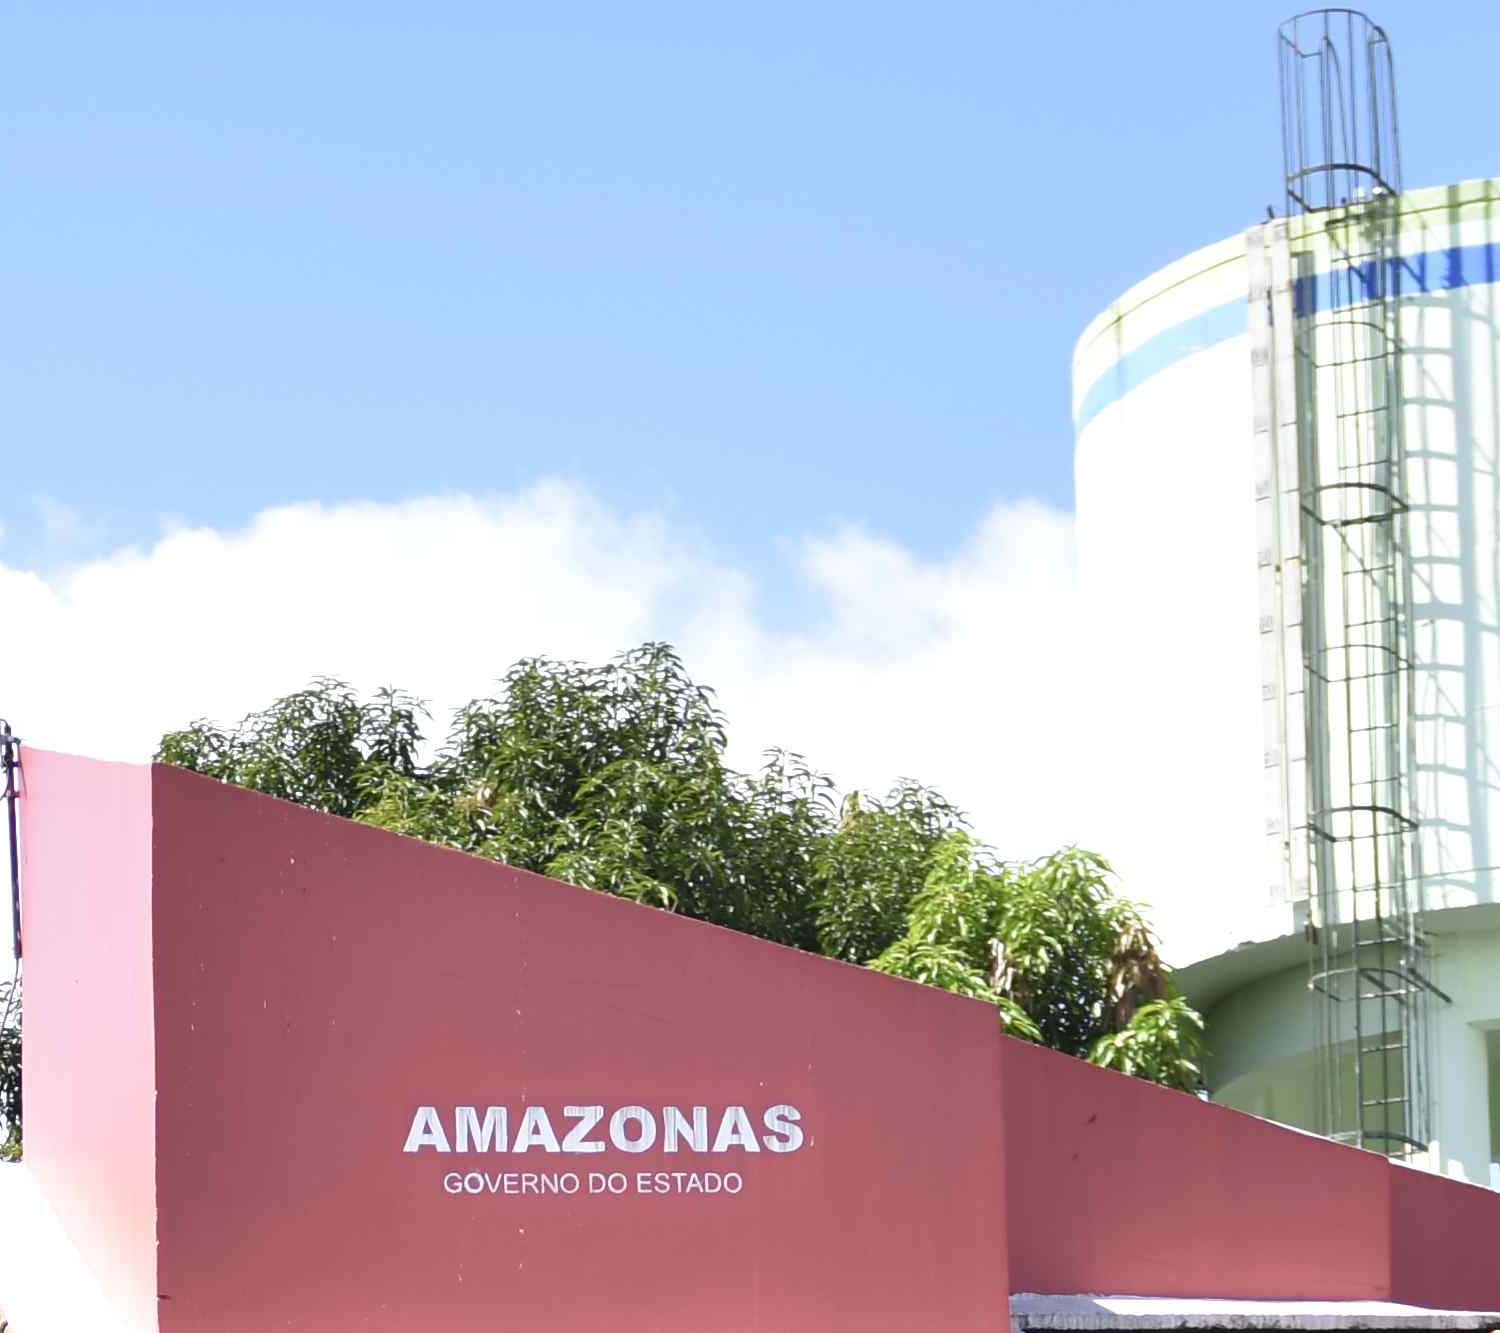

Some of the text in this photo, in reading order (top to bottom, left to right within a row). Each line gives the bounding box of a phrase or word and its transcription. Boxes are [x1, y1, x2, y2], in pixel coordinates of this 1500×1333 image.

[403, 1105, 803, 1153] AMAZONAS
[443, 1172, 743, 1194] GOVERNO DO ESTADO
